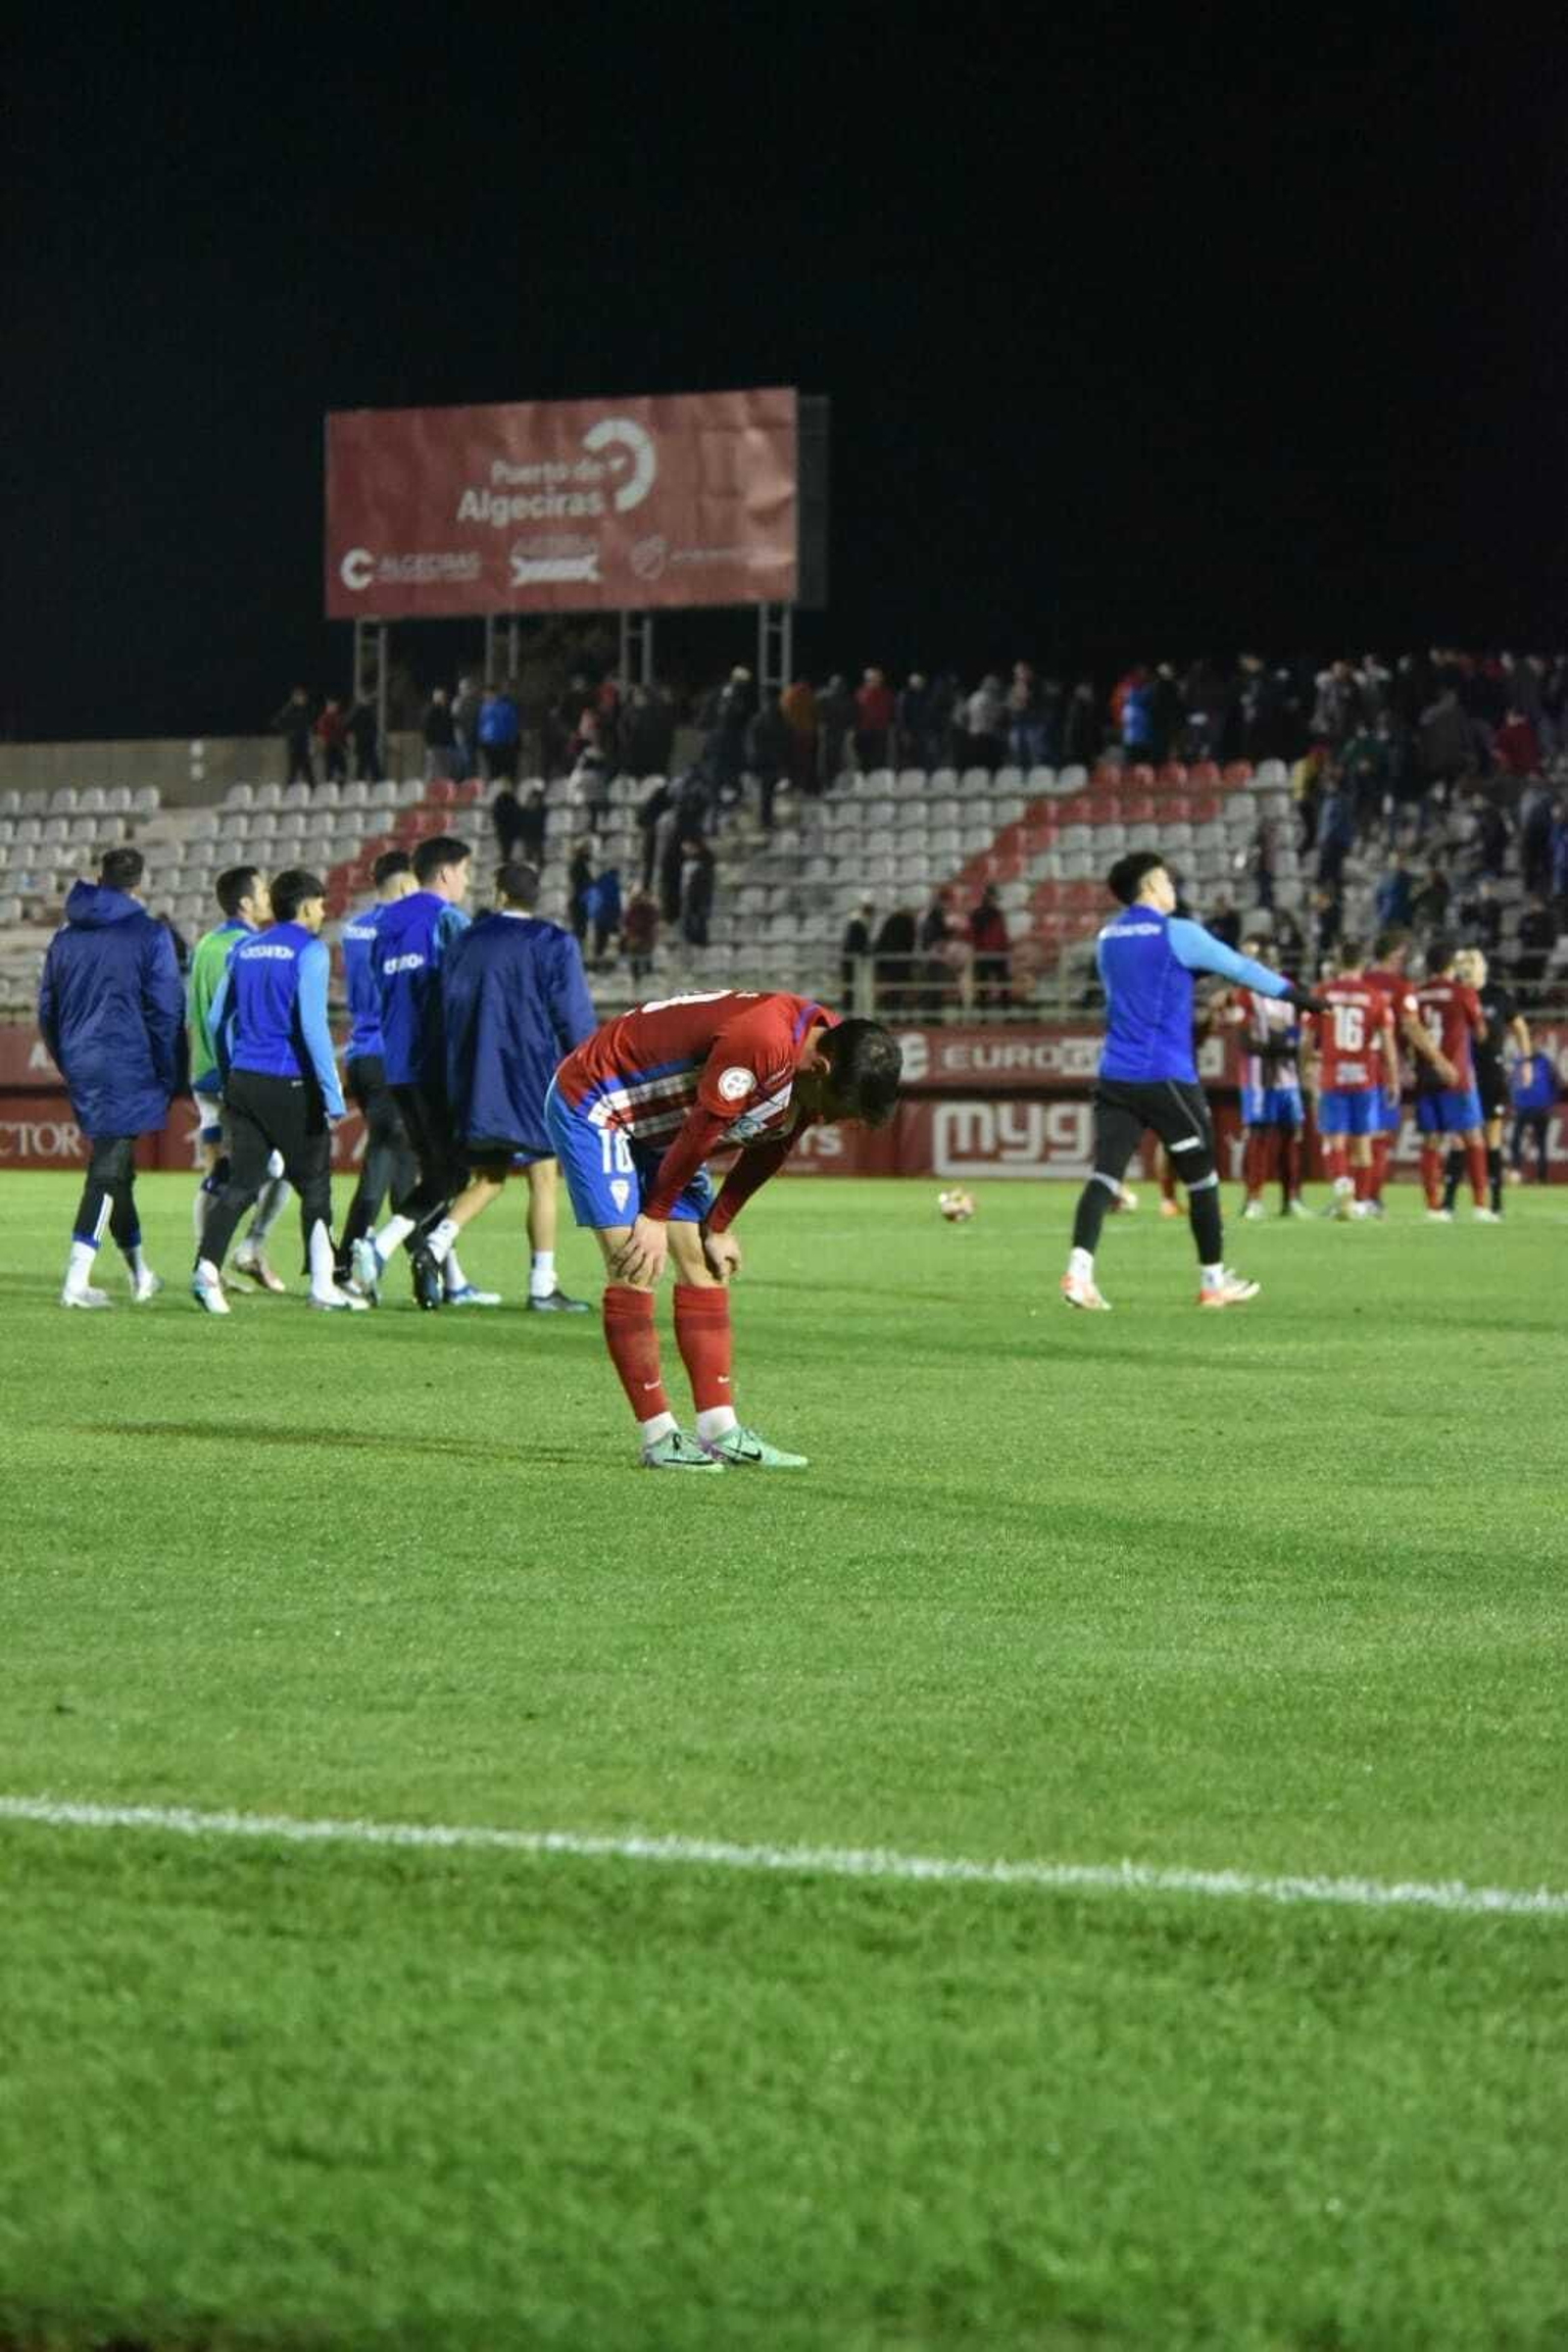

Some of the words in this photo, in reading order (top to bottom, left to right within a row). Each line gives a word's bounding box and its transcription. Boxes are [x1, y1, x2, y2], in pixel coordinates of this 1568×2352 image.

[492, 459, 566, 486] Puerto
[456, 489, 606, 529] Algeciras
[1333, 1004, 1364, 1053] 16
